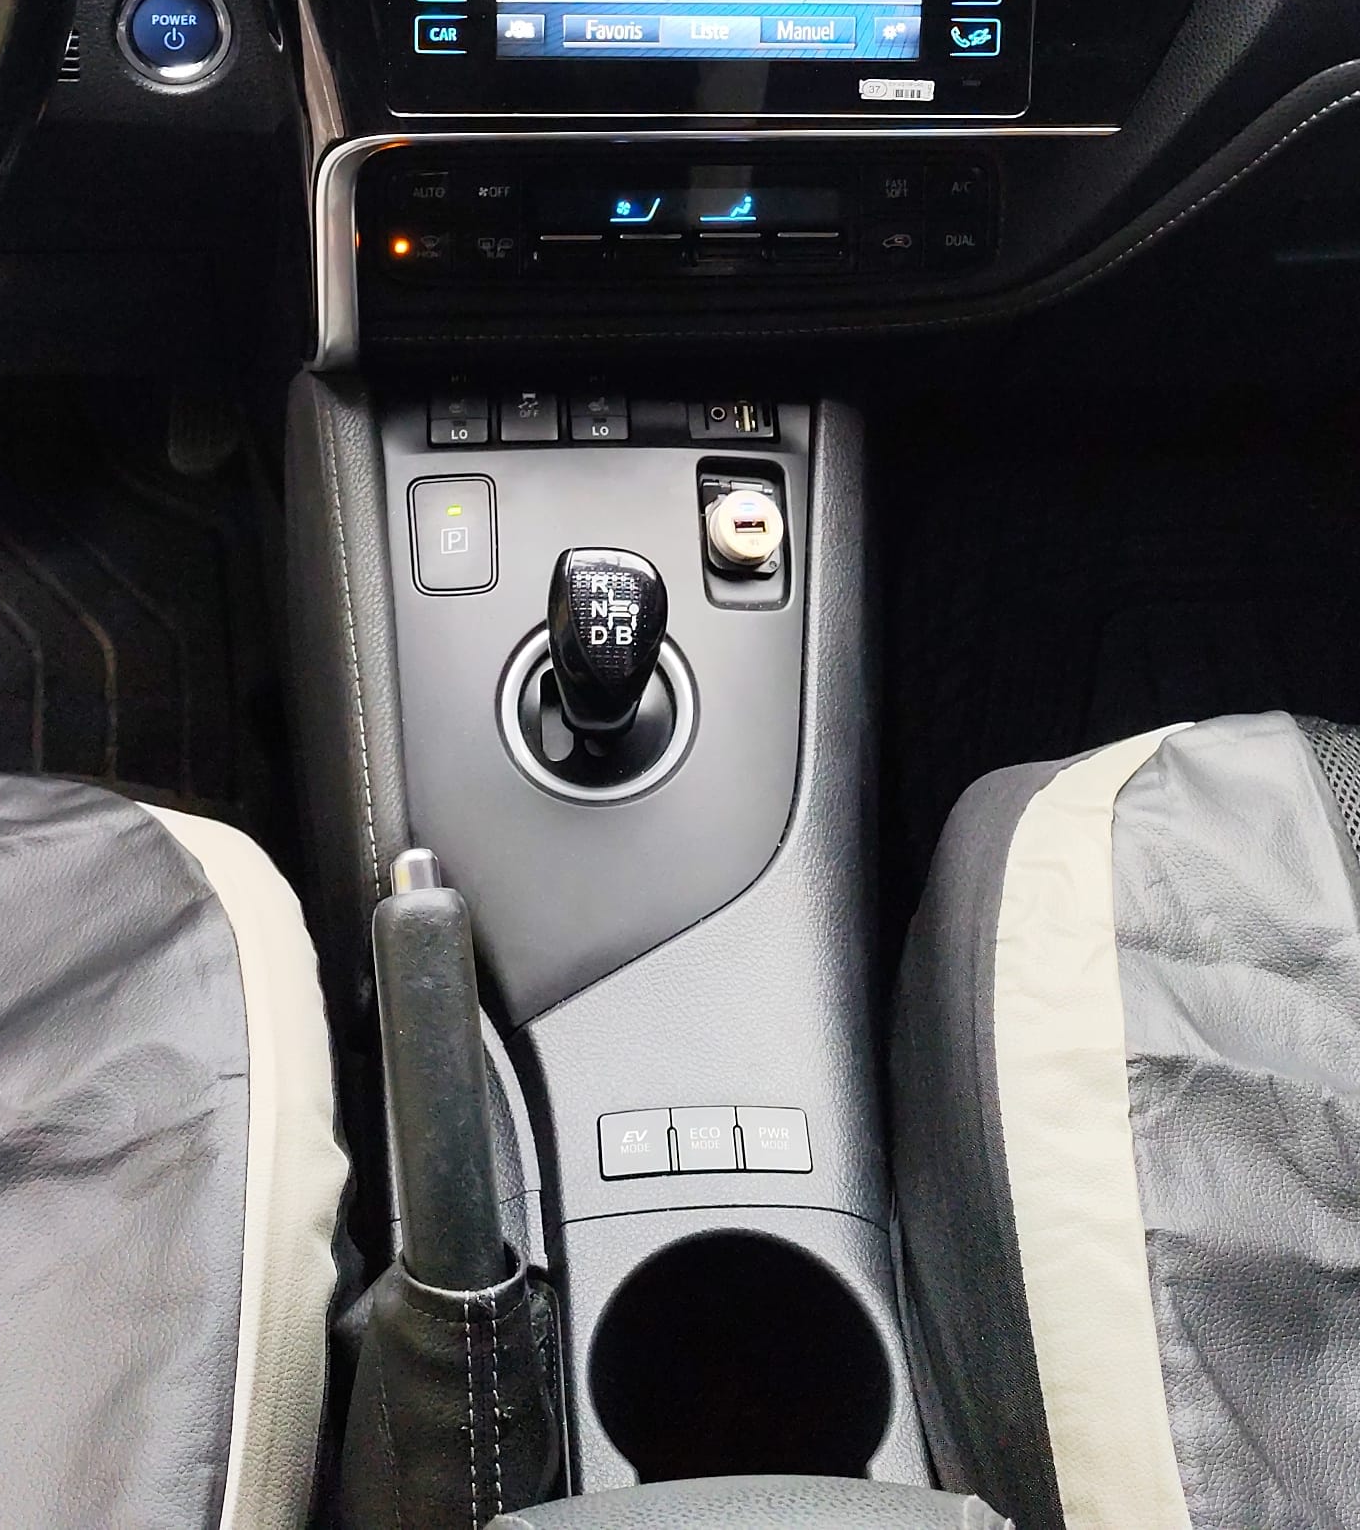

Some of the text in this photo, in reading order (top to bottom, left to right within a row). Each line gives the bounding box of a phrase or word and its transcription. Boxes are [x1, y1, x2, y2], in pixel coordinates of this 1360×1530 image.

[151, 14, 197, 26] POWER
[429, 27, 458, 42] CAR
[585, 19, 643, 40] Favoris
[690, 20, 729, 40] Liste
[776, 20, 835, 41] Manuel
[412, 187, 446, 199] AUTO
[489, 187, 511, 199] OFF
[945, 235, 976, 247] DUAL
[519, 409, 540, 419] OFF
[451, 429, 469, 440] LO
[591, 426, 610, 437] LO
[591, 574, 609, 593] R
[591, 600, 608, 618] N
[590, 625, 633, 645] D B
[622, 1130, 648, 1143] EV
[690, 1127, 721, 1139] ECO
[759, 1127, 790, 1139] PWR
[621, 1143, 651, 1153] MODE
[691, 1140, 721, 1150] MODE
[761, 1140, 791, 1150] MODE
